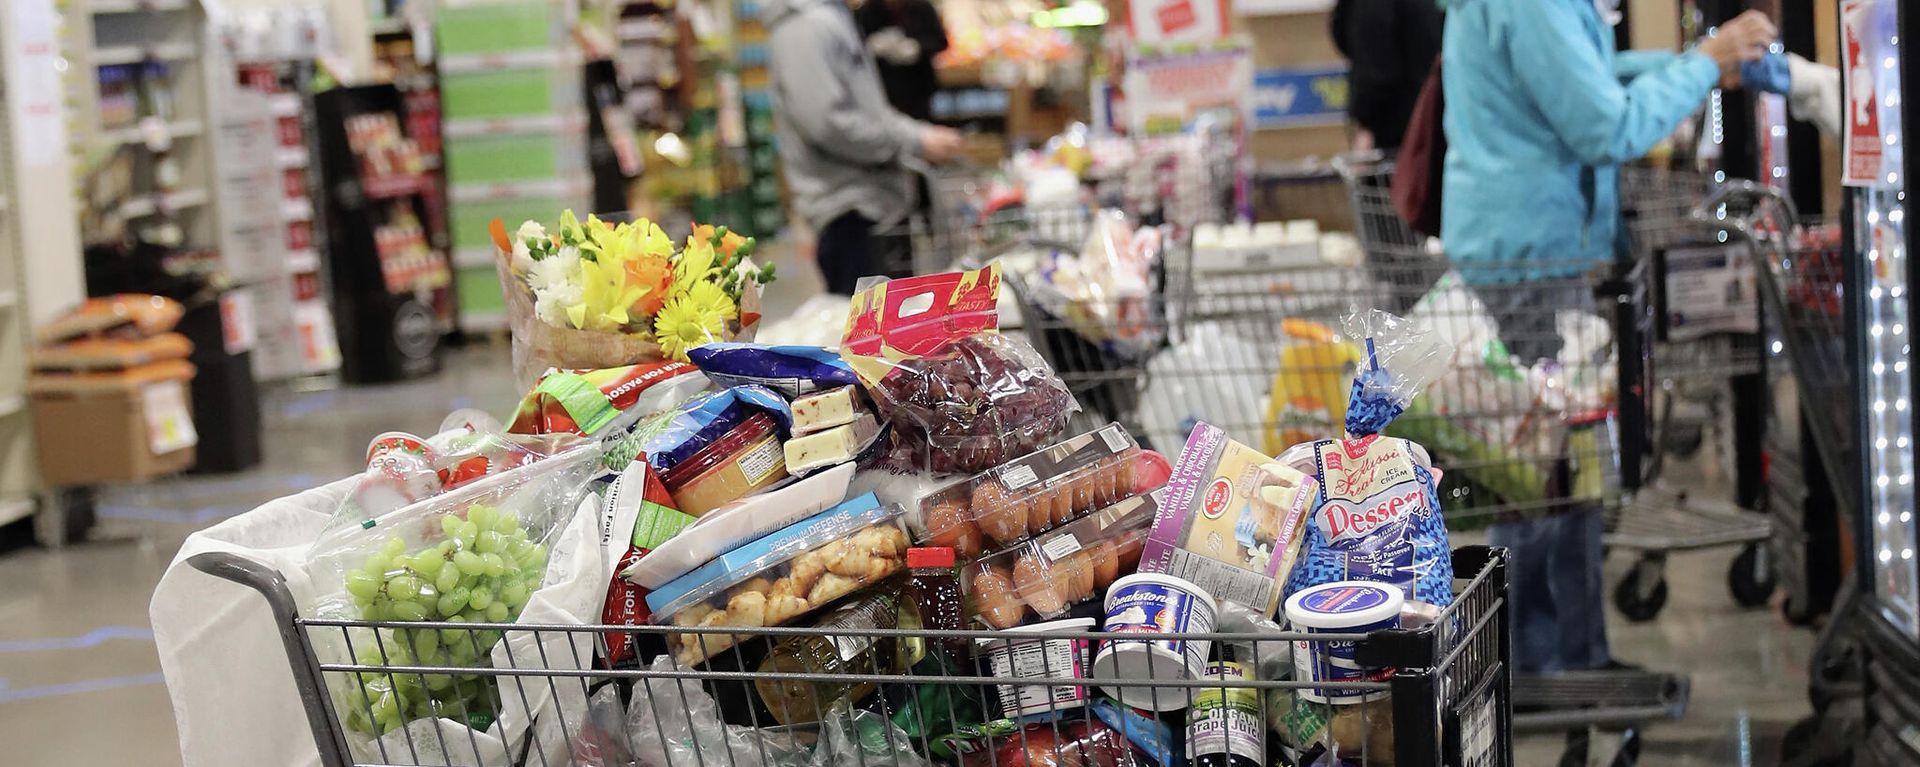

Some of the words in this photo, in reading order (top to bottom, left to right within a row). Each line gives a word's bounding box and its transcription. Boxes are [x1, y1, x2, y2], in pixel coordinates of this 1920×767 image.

[641, 368, 664, 381] FOR
[605, 377, 643, 401] PASSOV
[1380, 469, 1408, 484] CREAM
[608, 474, 623, 514] utrition
[1165, 486, 1184, 520] VANILLA
[1179, 479, 1199, 511] VANILLA
[807, 510, 852, 535] DEFENSE
[1324, 488, 1425, 540] Dessert
[1412, 506, 1430, 521] up
[625, 590, 635, 615] FOR
[1190, 719, 1226, 734] rape
